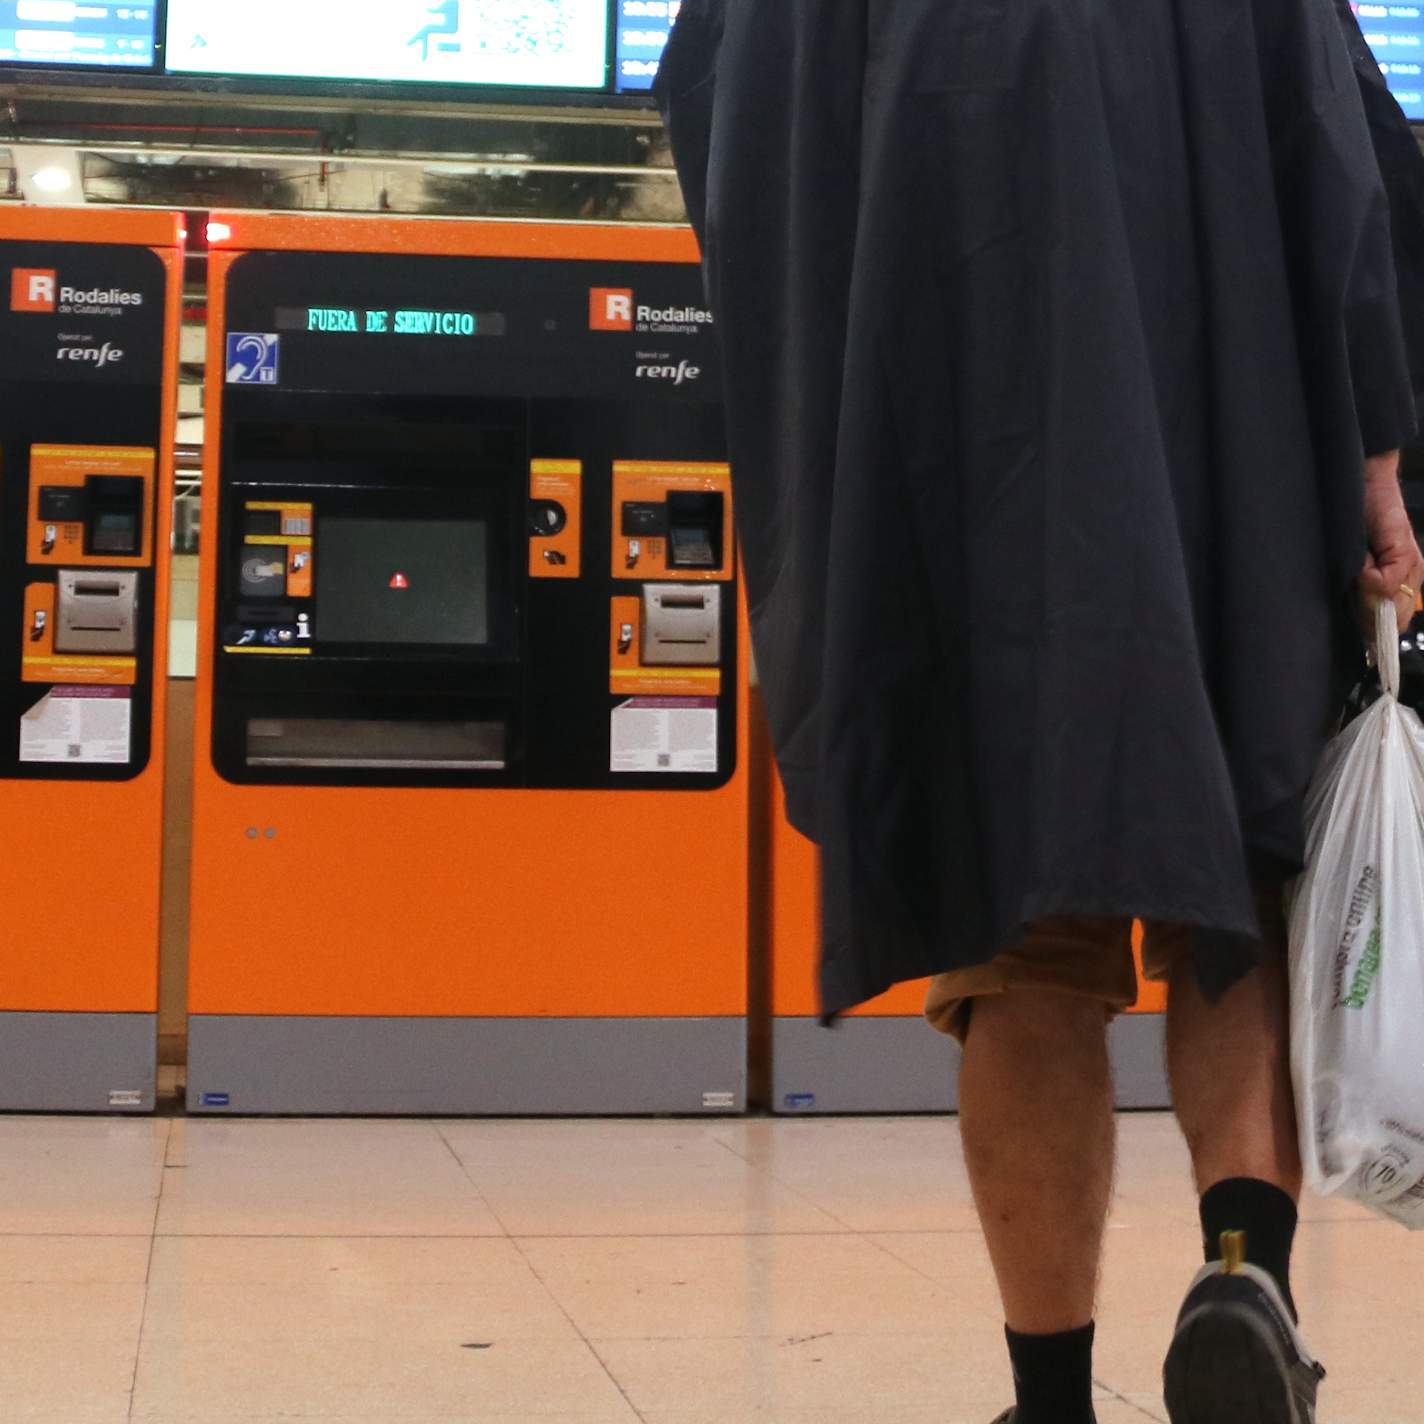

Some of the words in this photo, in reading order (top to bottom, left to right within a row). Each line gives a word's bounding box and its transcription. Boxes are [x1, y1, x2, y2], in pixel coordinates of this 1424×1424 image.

[28, 275, 54, 302] R
[60, 287, 143, 305] Rodalies
[605, 294, 631, 321] R
[636, 305, 713, 324] Rodalies
[306, 307, 359, 333] FUERA
[365, 310, 388, 334] DE
[393, 310, 475, 336] SERVICIO
[56, 342, 124, 368] renfe
[635, 360, 701, 385] renfe
